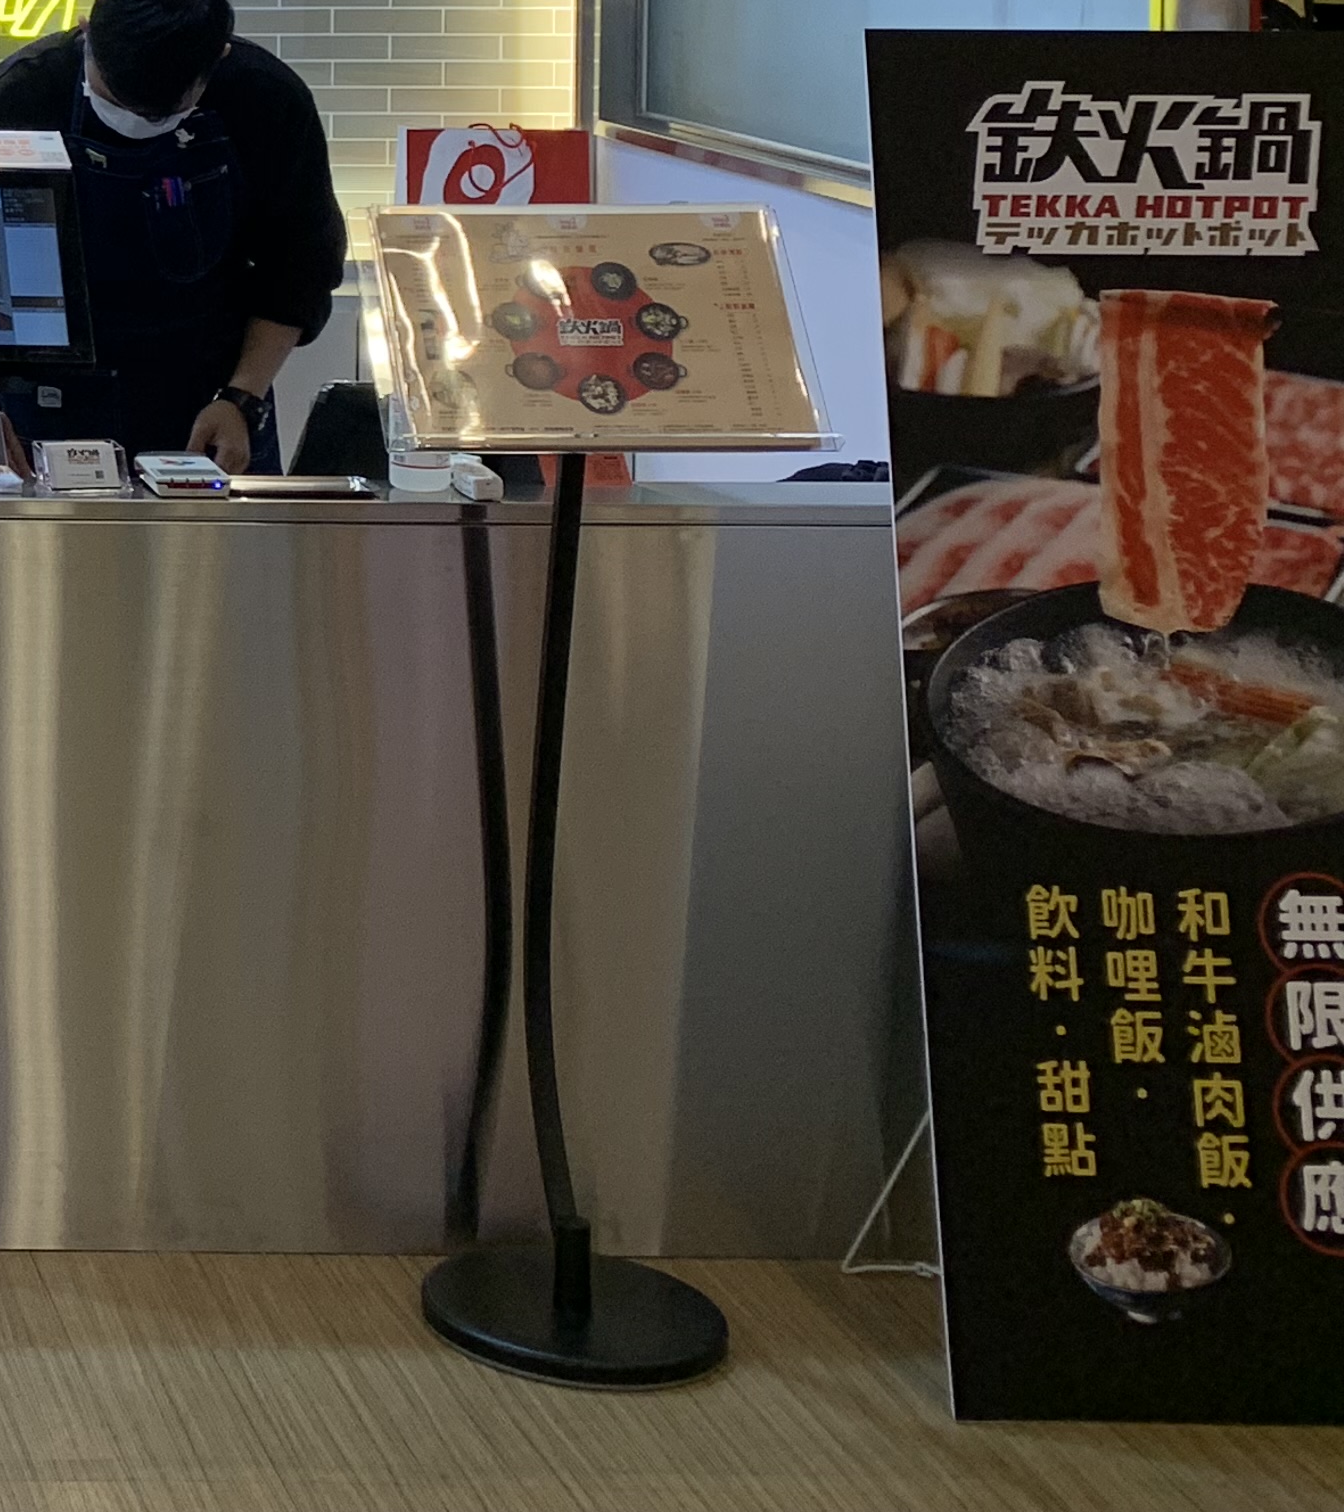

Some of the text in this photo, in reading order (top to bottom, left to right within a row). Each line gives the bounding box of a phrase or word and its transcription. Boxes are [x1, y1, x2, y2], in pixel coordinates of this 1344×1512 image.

[982, 194, 1309, 220] TEKKA HOTPOT
[985, 221, 1315, 248] テッカホットポット
